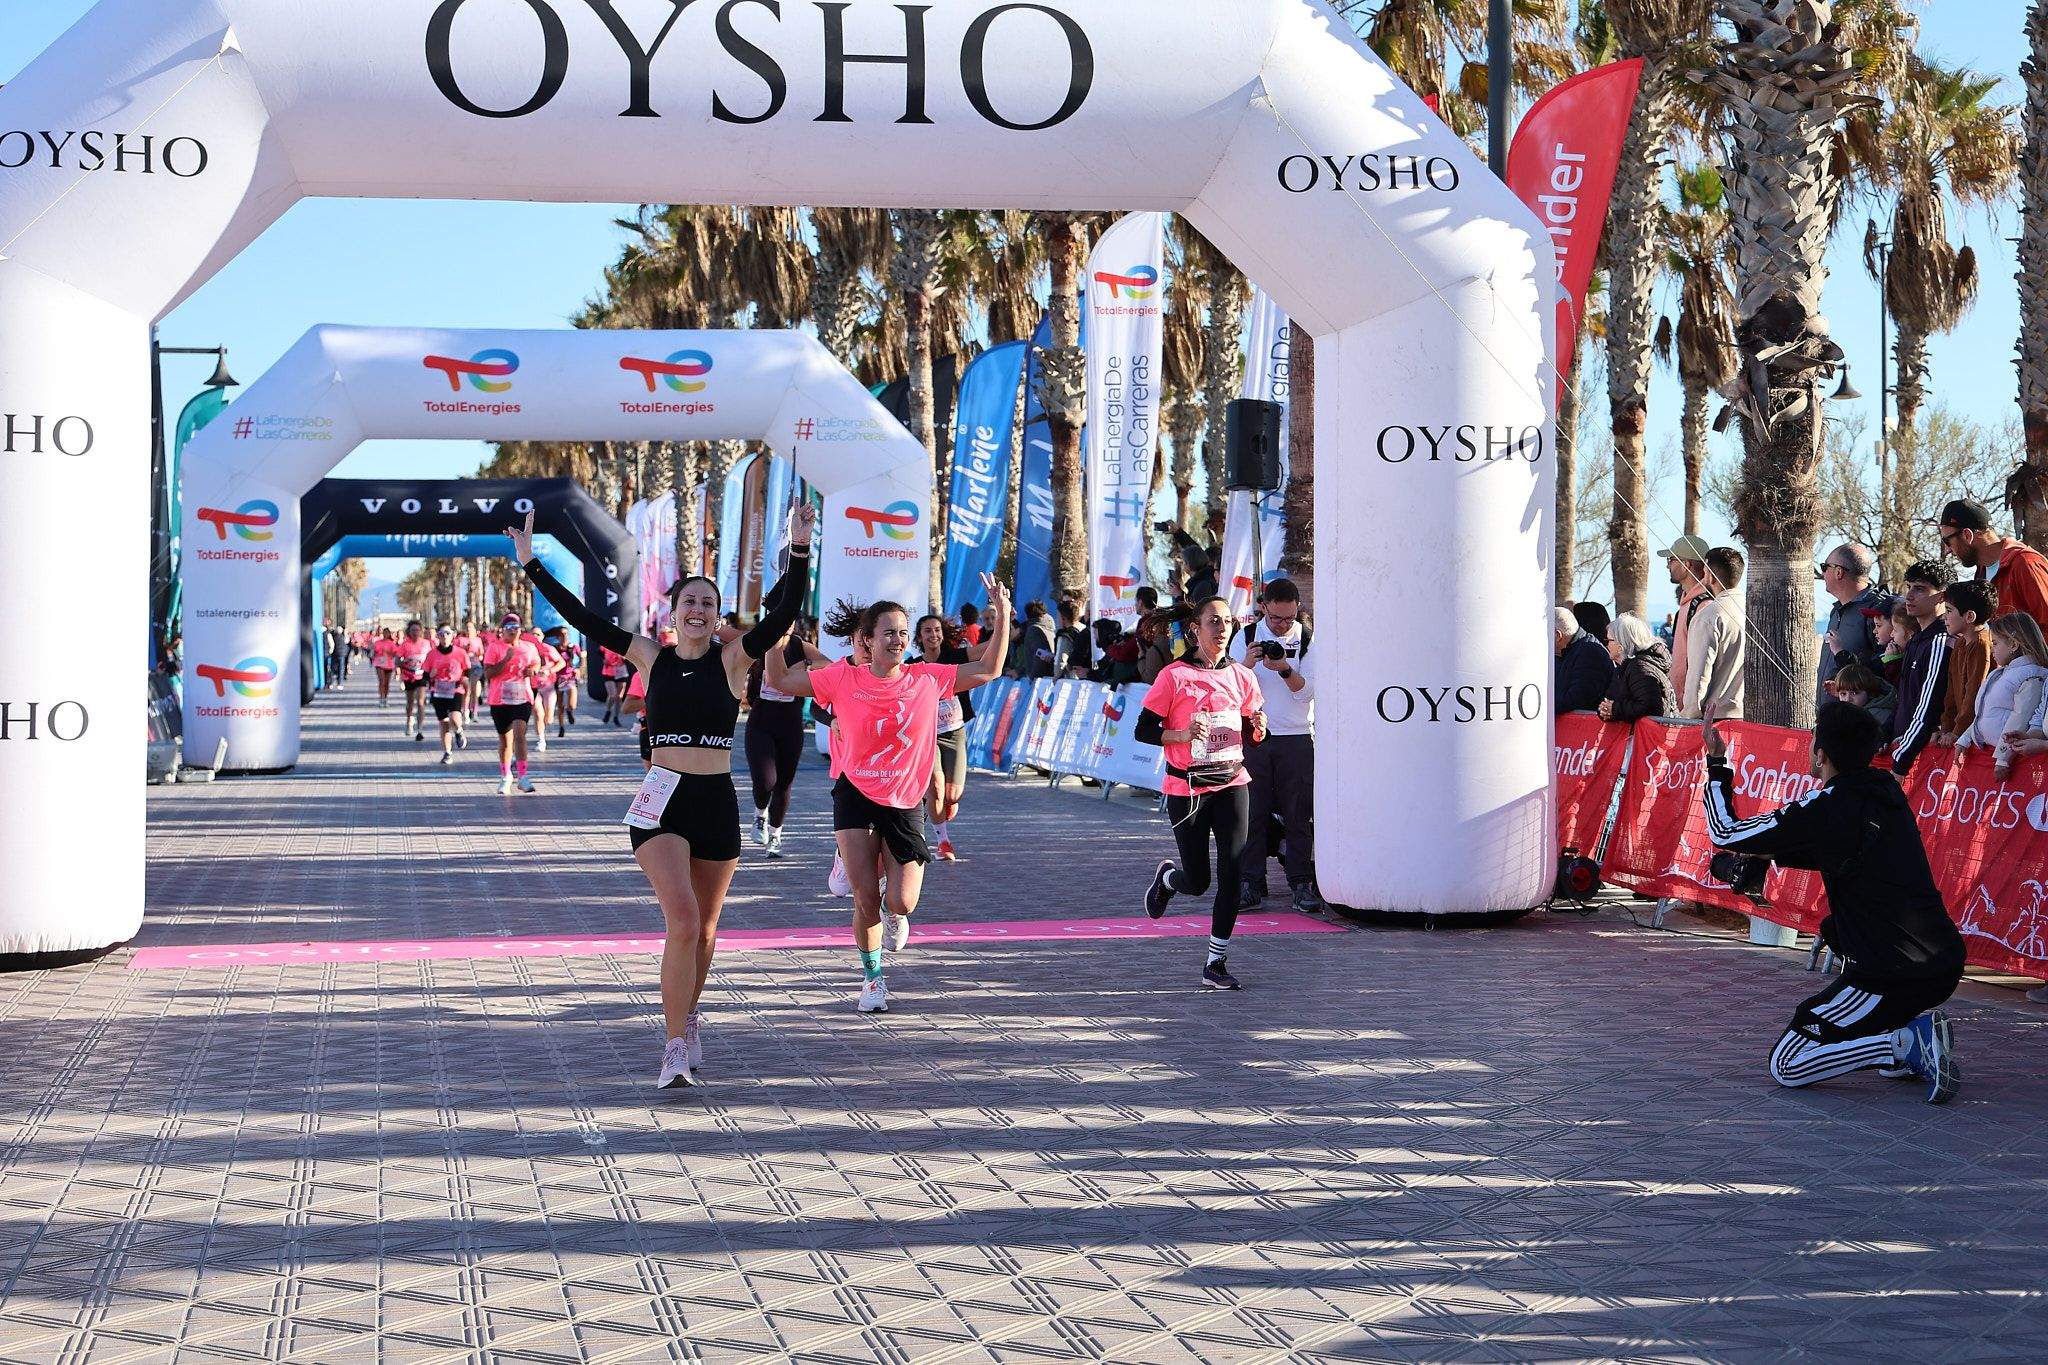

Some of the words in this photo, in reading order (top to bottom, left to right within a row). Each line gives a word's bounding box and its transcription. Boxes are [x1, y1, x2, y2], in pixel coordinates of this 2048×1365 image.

[427, 0, 1094, 131] OYSHO
[0, 131, 208, 177] OYSHO
[1278, 154, 1459, 192] OYSHO
[1094, 305, 1158, 317] TotalEnergies
[424, 401, 521, 415] TotalEnergies
[620, 402, 714, 415] TotalEnergies
[1128, 354, 1149, 485] LasCarreras
[256, 428, 333, 441] LasCarreras
[1376, 425, 1542, 462] OYSHO
[949, 424, 1002, 548] Marlene
[360, 498, 535, 514] VOLVO
[196, 549, 279, 562] TotalEnergies
[843, 547, 919, 560] TotalEnergies
[196, 608, 279, 619] totalenergies.es
[1375, 683, 1542, 724] OYSHO
[195, 706, 278, 718] TotalEnergies
[656, 734, 692, 745] PRO
[699, 735, 733, 747] NIKE
[1919, 768, 2025, 834] Sports
[186, 945, 433, 959] OYSHO
